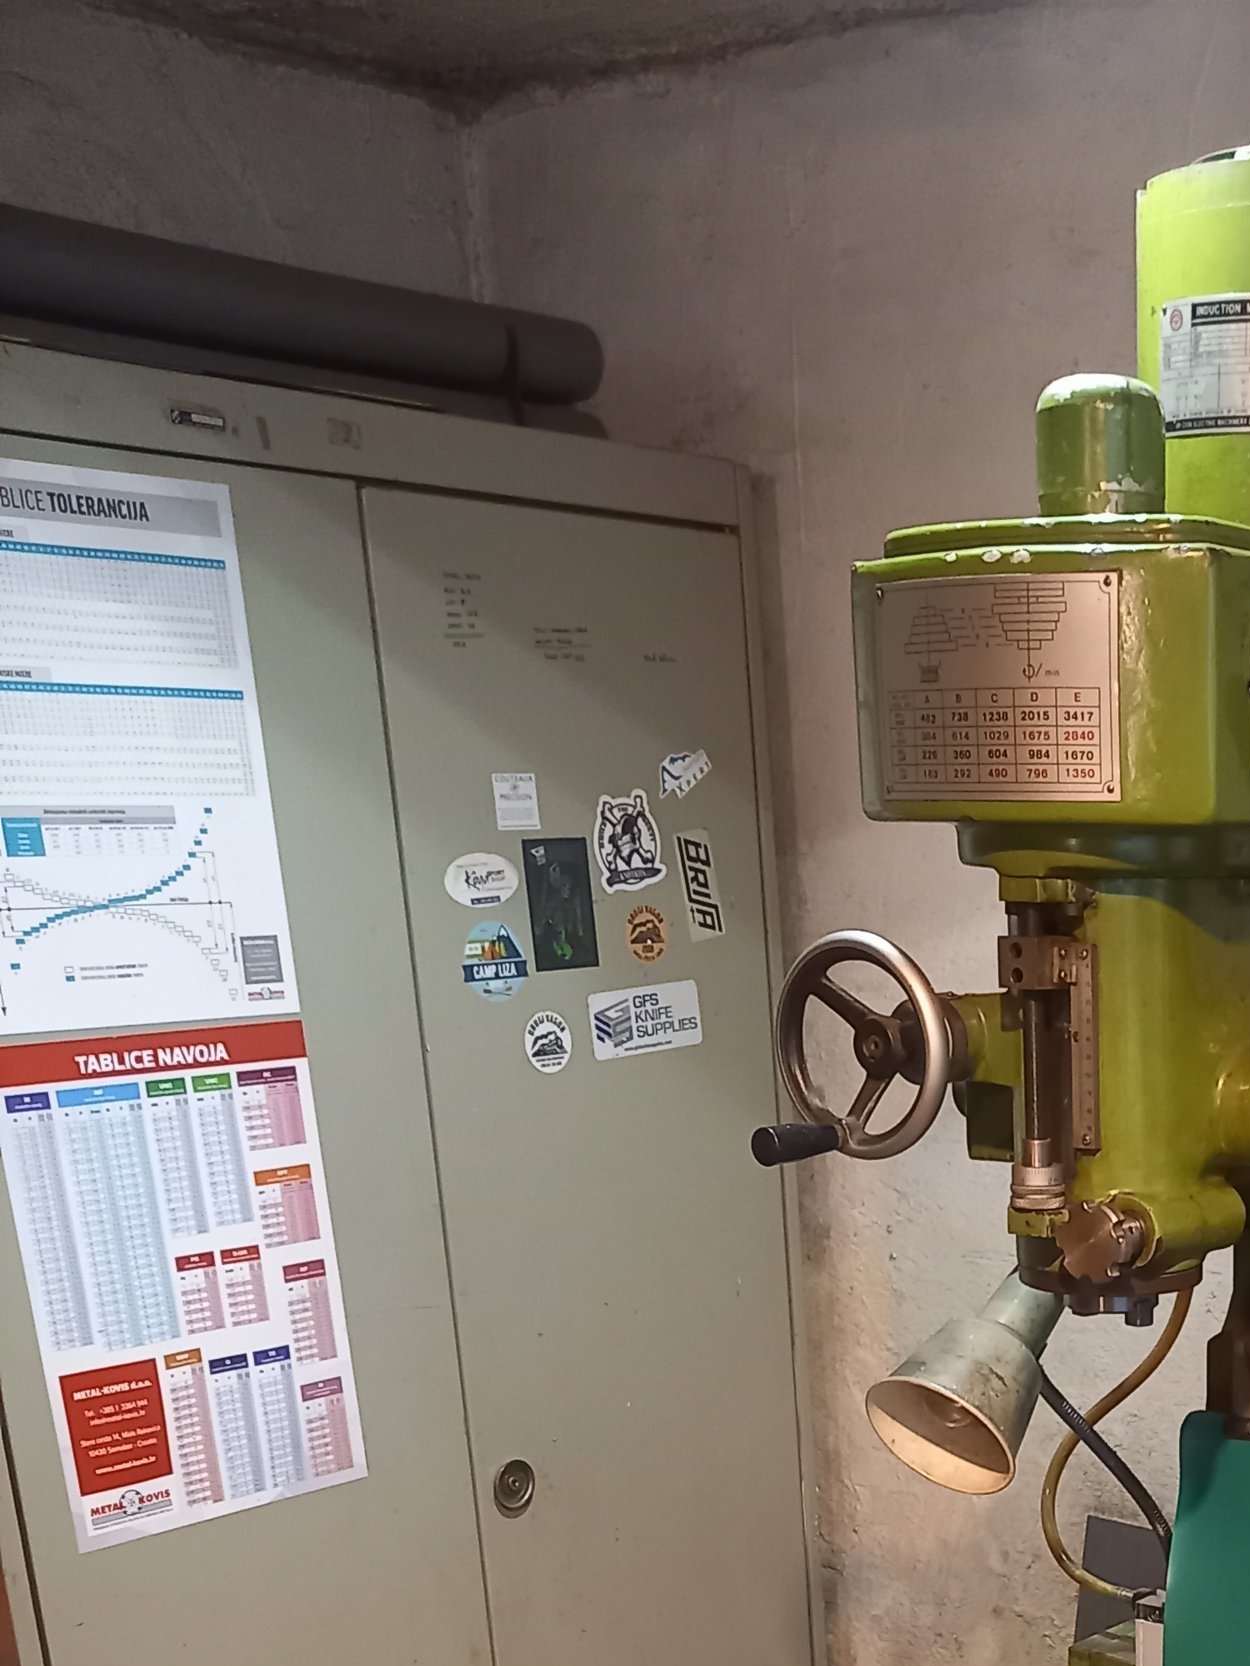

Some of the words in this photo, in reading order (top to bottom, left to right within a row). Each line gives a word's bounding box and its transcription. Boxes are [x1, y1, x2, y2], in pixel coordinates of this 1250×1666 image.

[1196, 303, 1241, 316] INDUCTION
[47, 491, 150, 522] TOLERANCIJA
[991, 693, 998, 703] C
[1030, 692, 1039, 702] D
[1074, 692, 1081, 702] E
[982, 711, 1009, 722] 1238
[1020, 710, 1050, 721] 2015
[1063, 710, 1094, 722] 3417
[983, 730, 1009, 741] 1029
[1022, 730, 1050, 741] 1675
[1063, 730, 1095, 741] 2840
[987, 749, 1008, 759] 604
[1028, 749, 1050, 760] 984
[1064, 750, 1094, 761] 1670
[954, 768, 971, 778] 292
[988, 768, 1008, 778] 490
[1026, 768, 1048, 779] 796
[1065, 768, 1095, 778] 1350
[473, 964, 497, 980] CAMP
[498, 962, 518, 977] LIZA
[634, 1005, 673, 1024] KNIFE
[636, 1016, 698, 1038] SUPPLIES
[74, 1048, 156, 1075] TABLICE
[157, 1042, 230, 1067] NAVOJA
[73, 1382, 130, 1401] METAL-KOVIS
[90, 1501, 127, 1517] METAL
[138, 1489, 171, 1504] KOVIS
